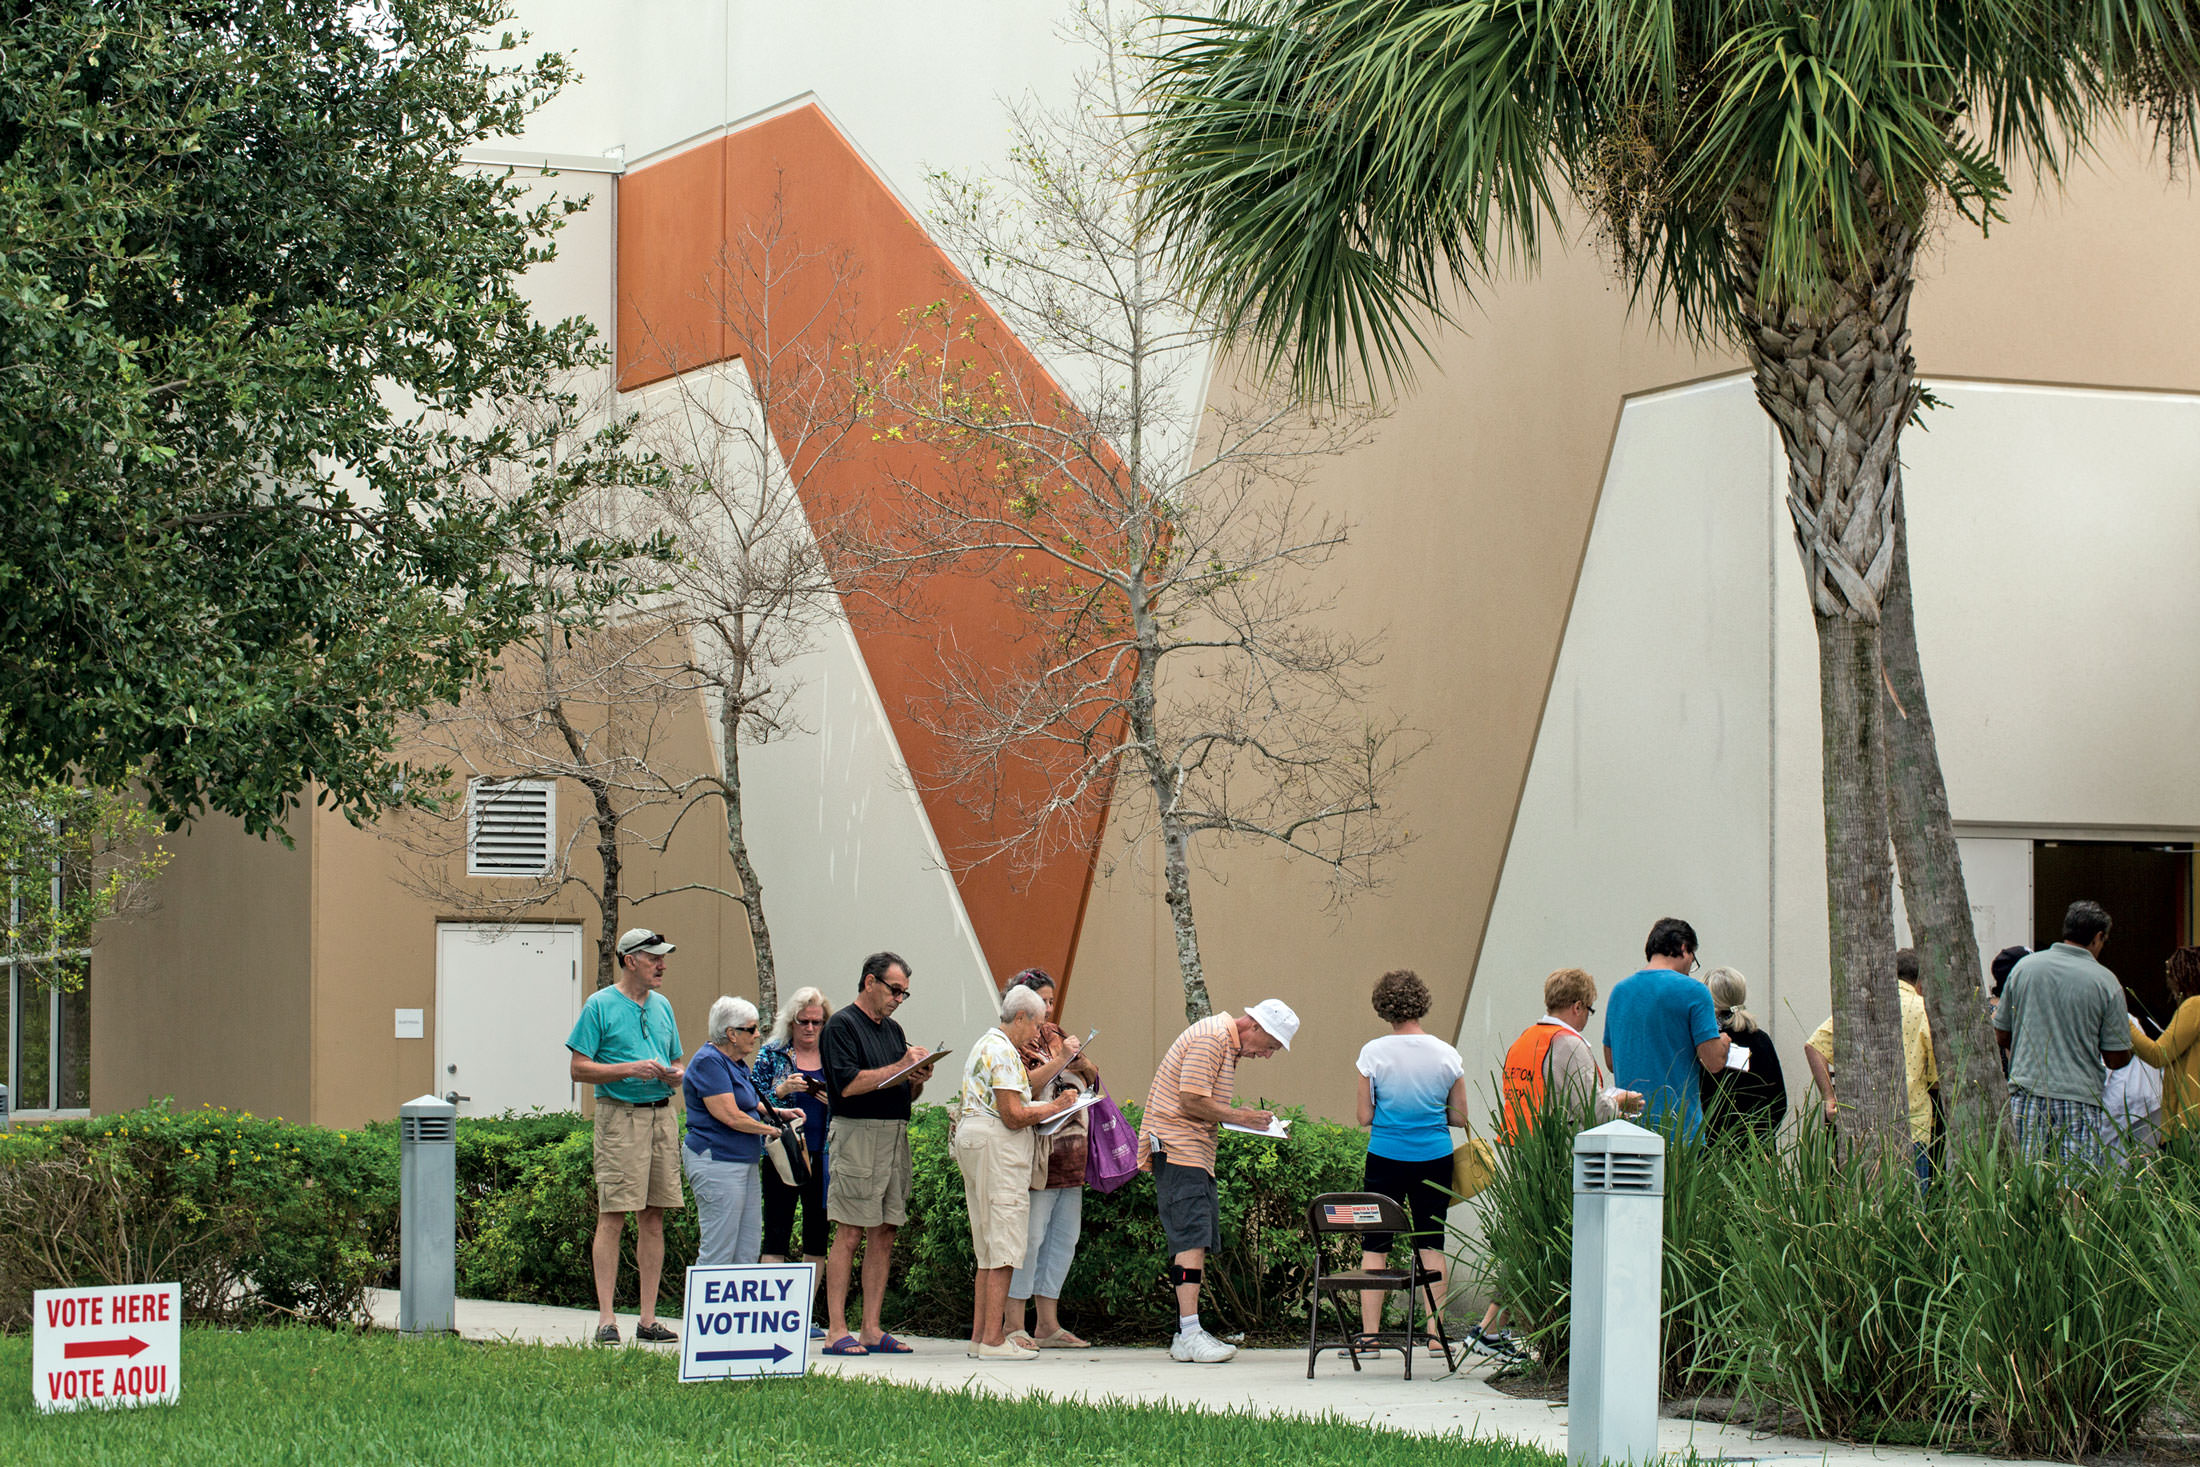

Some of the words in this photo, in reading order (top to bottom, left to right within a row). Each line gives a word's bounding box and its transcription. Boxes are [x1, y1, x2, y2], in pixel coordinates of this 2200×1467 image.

[705, 1279, 794, 1304] EARLY
[46, 1296, 103, 1328] VOTE
[112, 1293, 170, 1324] HERE
[696, 1310, 800, 1336] VOTING
[48, 1369, 104, 1401] VOTE
[112, 1365, 166, 1398] AQUI
